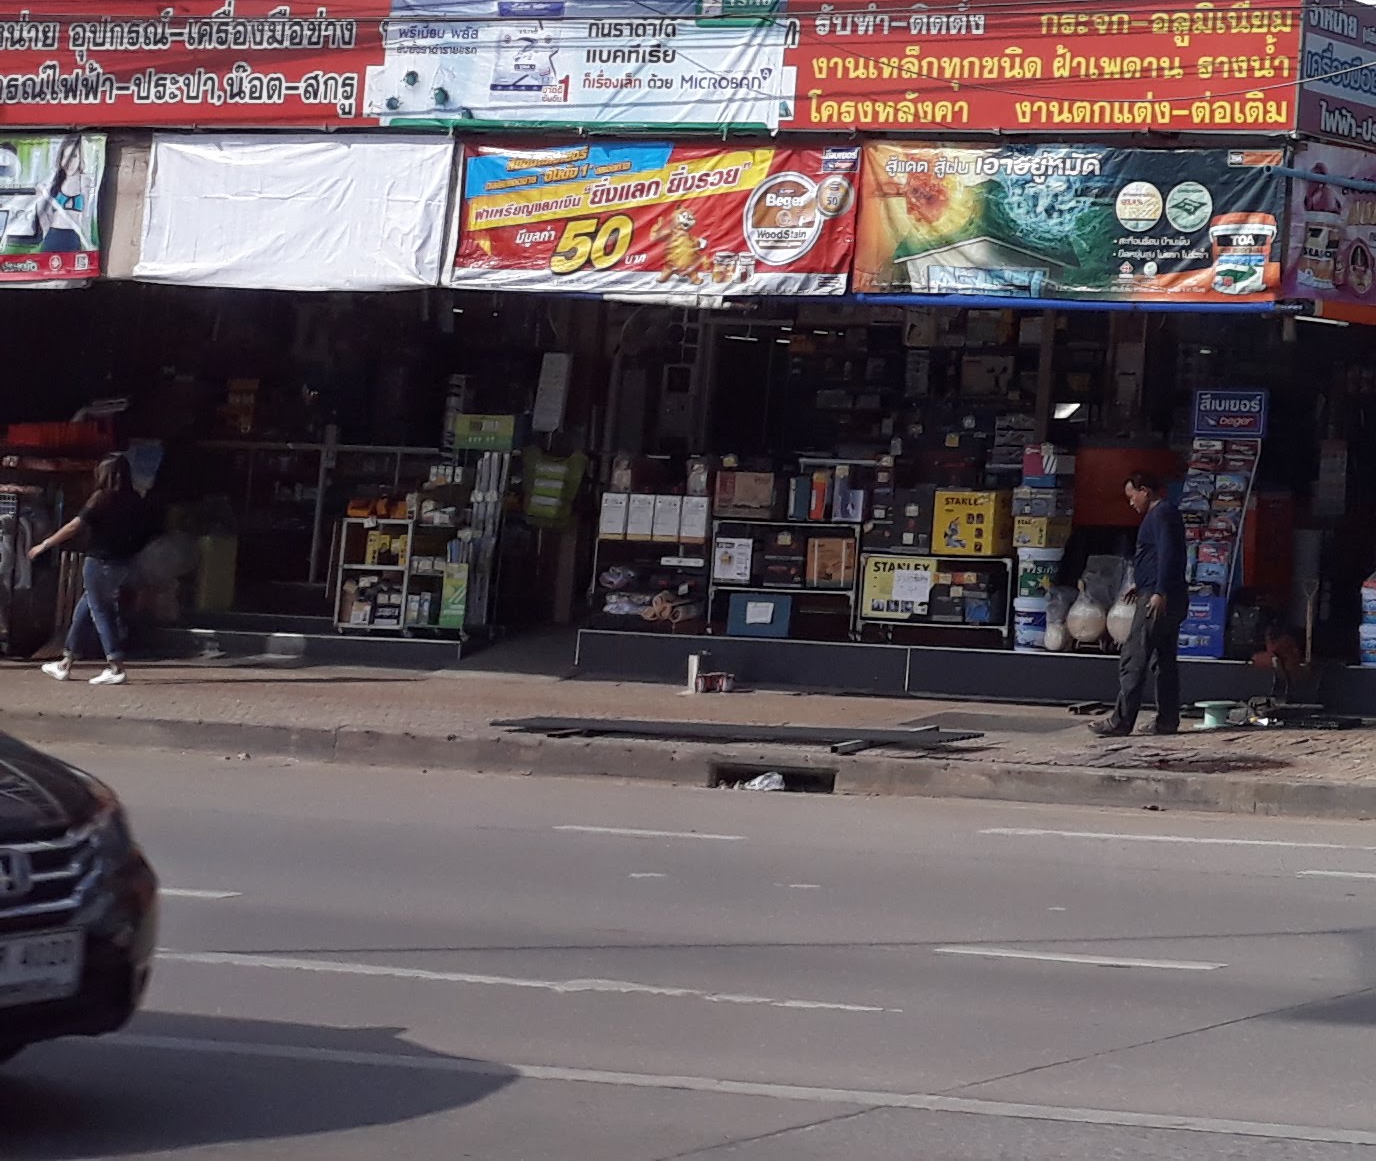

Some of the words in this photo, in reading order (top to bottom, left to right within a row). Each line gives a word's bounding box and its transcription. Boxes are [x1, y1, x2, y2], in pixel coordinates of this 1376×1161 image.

[586, 43, 676, 64] แบคทีเรีย
[811, 45, 1042, 91] งานเหล็กทุกชนิด
[1052, 44, 1183, 80] ฝ้าเพดาน
[1195, 36, 1290, 80] รางน้ำ
[647, 72, 673, 90] ด้วย
[807, 89, 969, 125] โครงหลังคา
[1015, 90, 1288, 126] งานตกแต่ง-ต่อเติม
[550, 215, 635, 276] 50
[1230, 235, 1256, 246] TOA
[1200, 392, 1262, 412] สีเบเยอร์
[944, 496, 981, 506] STANLE
